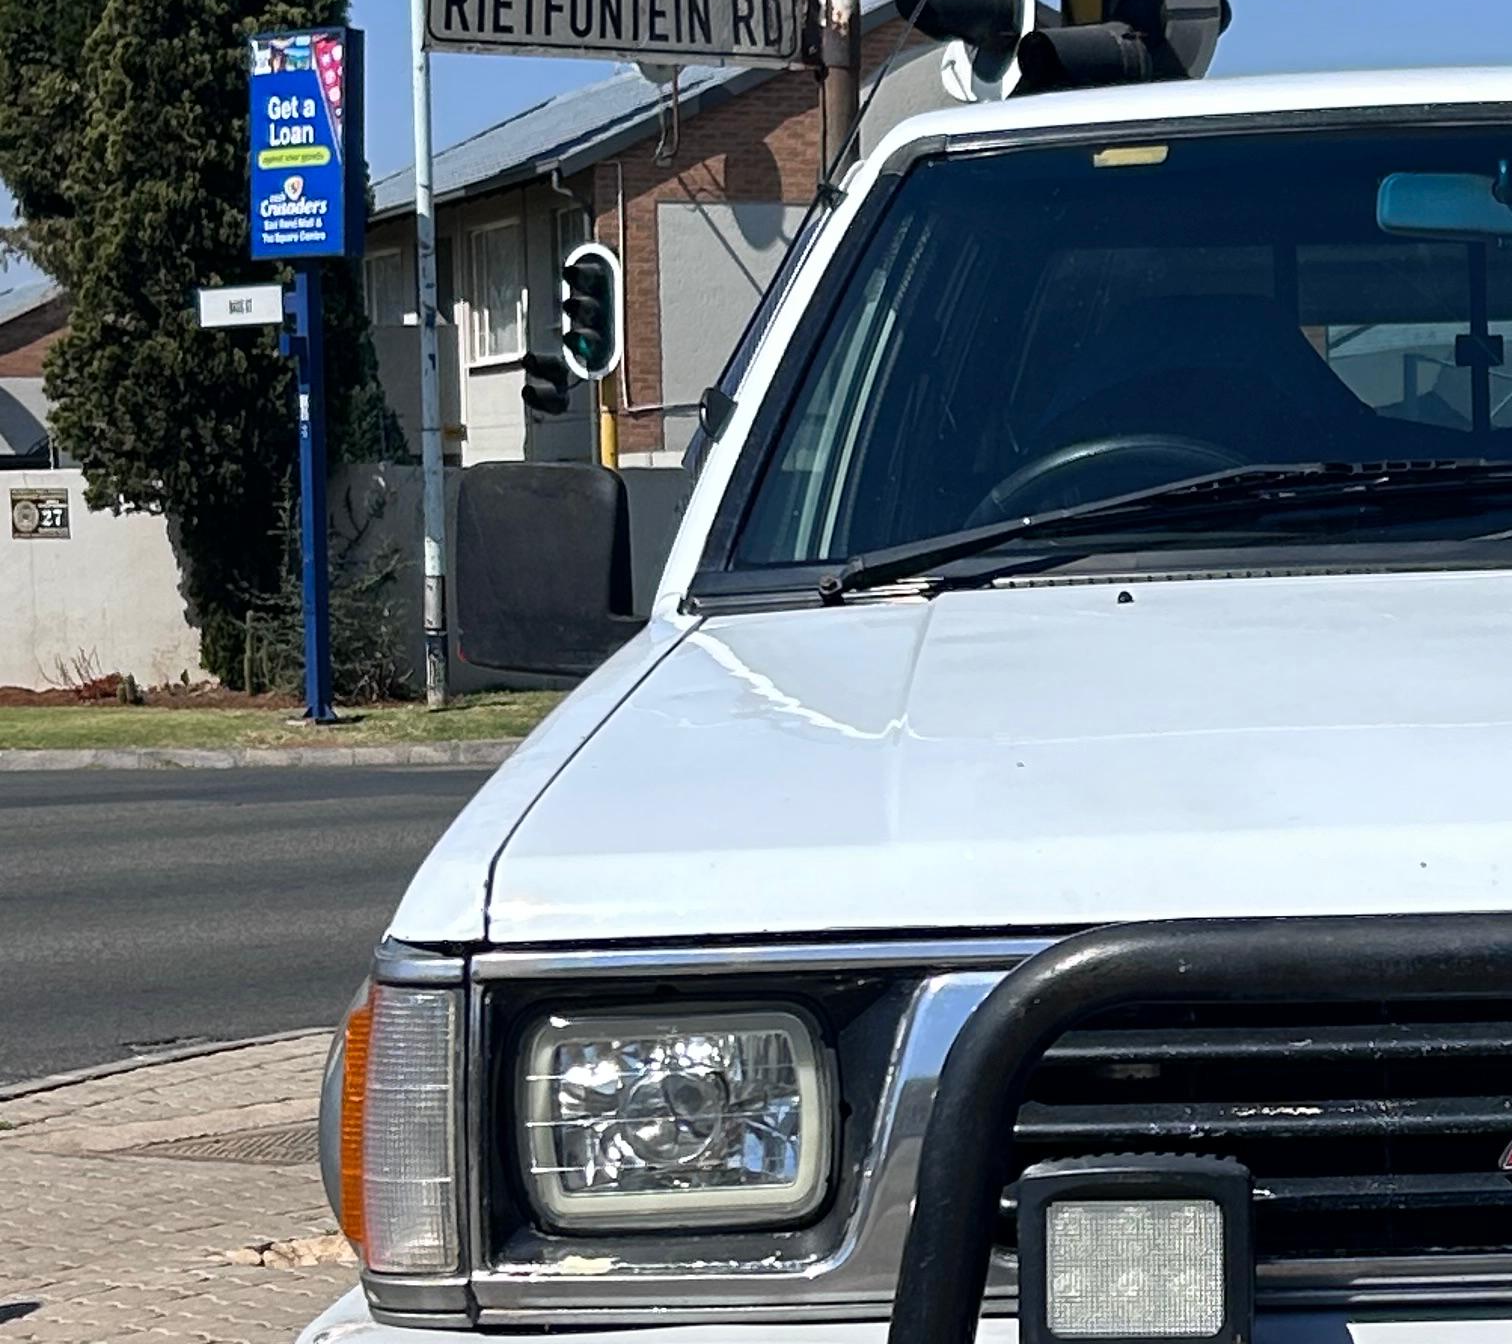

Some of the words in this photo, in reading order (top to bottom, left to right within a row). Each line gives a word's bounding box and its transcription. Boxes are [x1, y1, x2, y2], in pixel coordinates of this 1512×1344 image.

[267, 95, 299, 120] Get
[302, 98, 316, 118] a
[269, 122, 315, 147] Loan
[40, 508, 63, 527] 27
